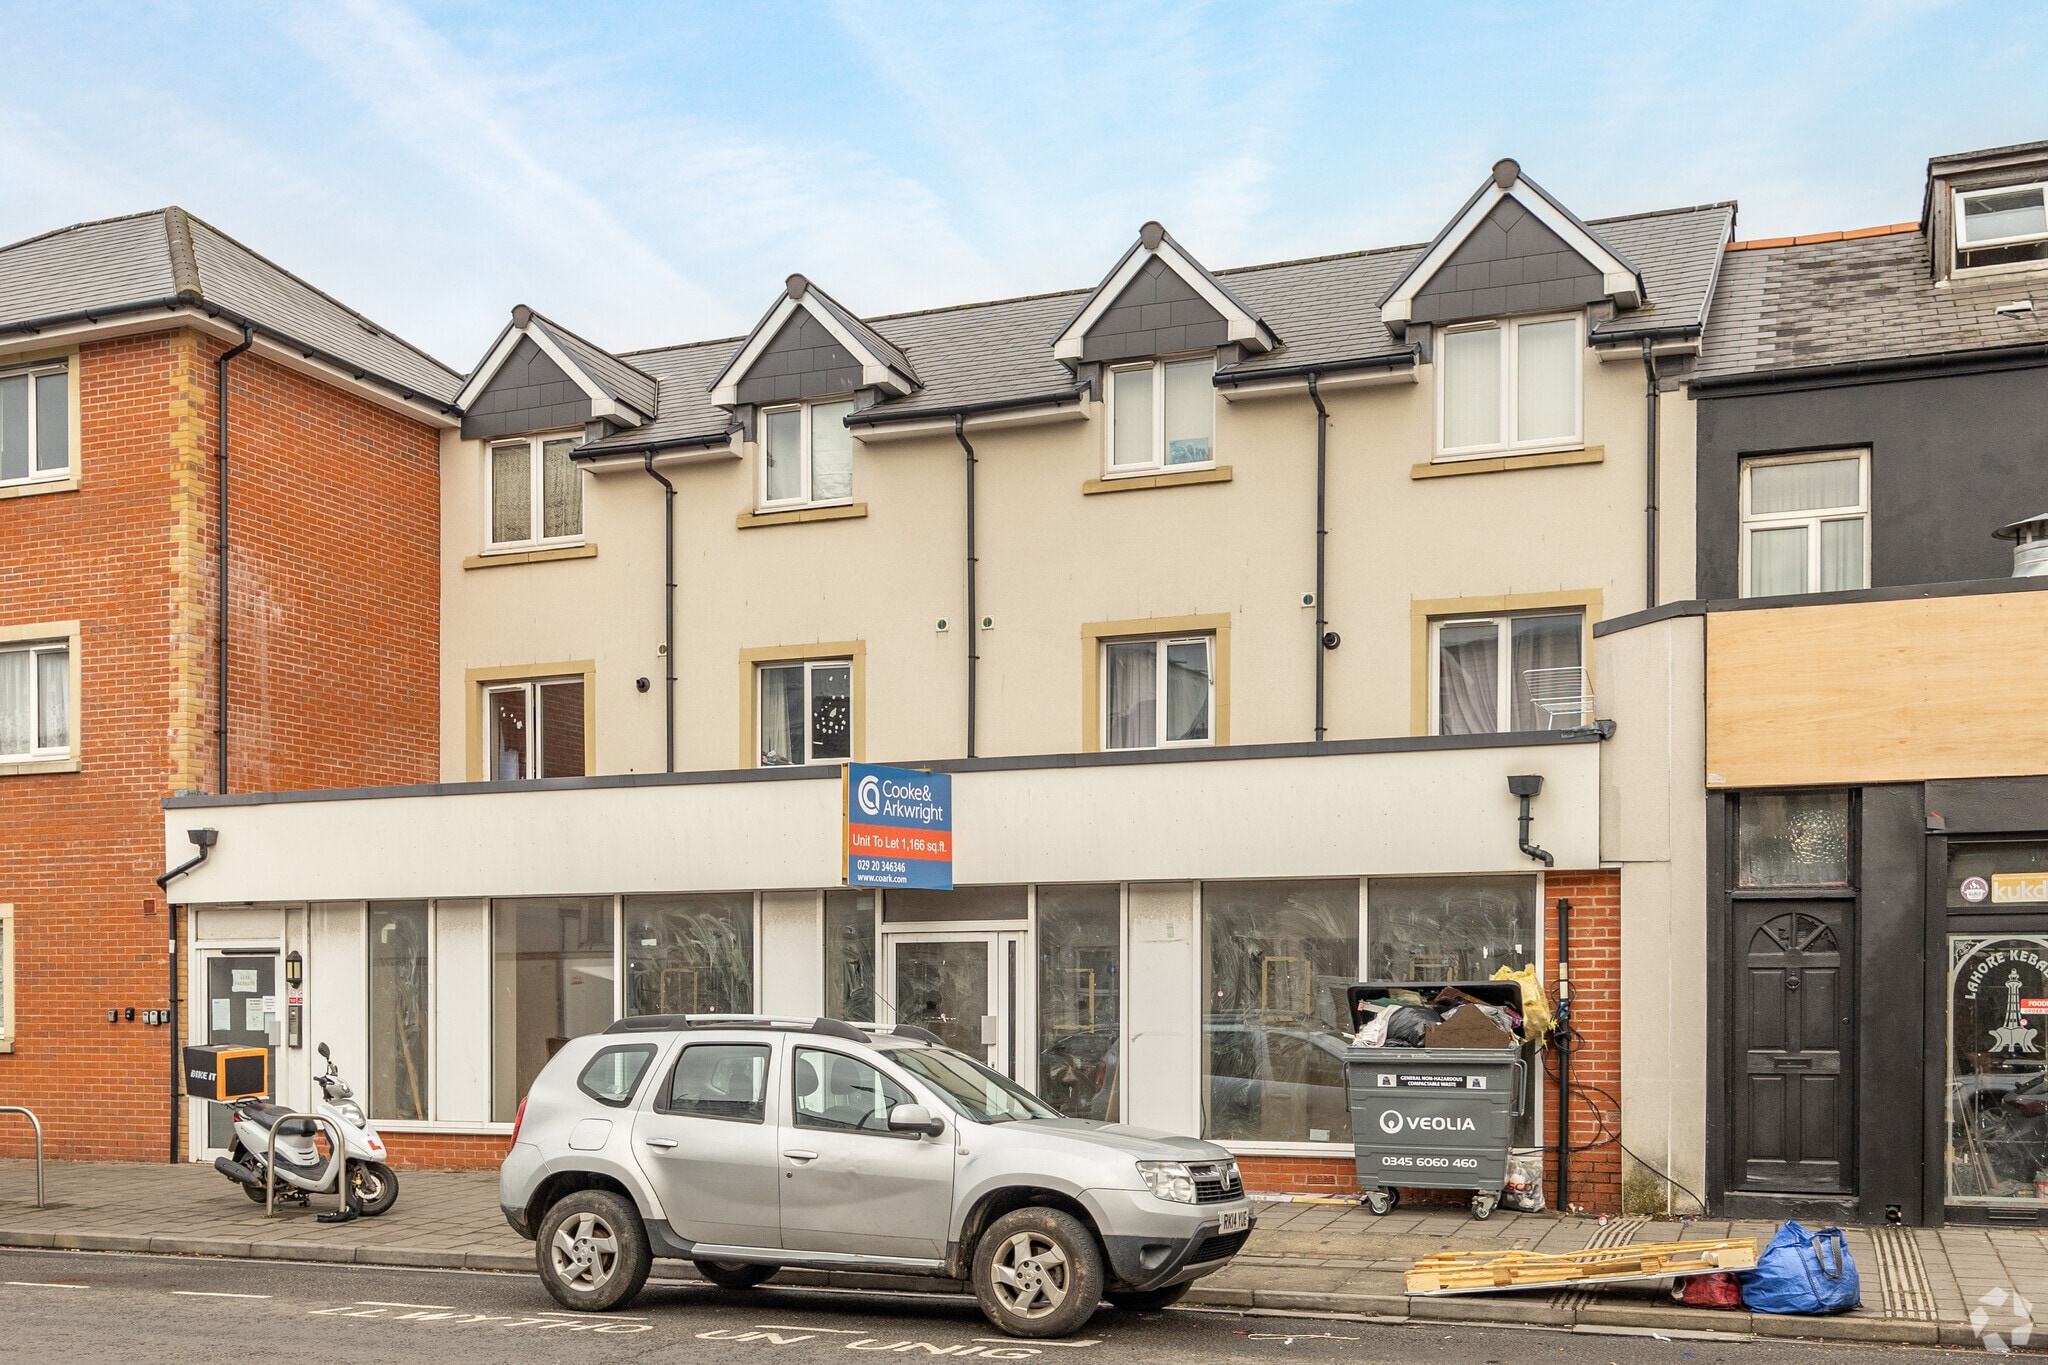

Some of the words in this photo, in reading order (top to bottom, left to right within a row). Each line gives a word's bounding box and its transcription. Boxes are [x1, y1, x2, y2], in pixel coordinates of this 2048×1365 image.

[882, 780, 932, 802] Cooke&
[882, 799, 943, 824] Arkwright
[852, 834, 871, 847] Unit
[872, 835, 883, 848] To
[885, 836, 899, 849] Let
[901, 838, 925, 851] 1,166
[927, 841, 947, 854] sq.ft.
[857, 859, 870, 870] 029
[871, 861, 880, 871] 20
[881, 861, 906, 872] 346346
[857, 873, 907, 884] www.coark.com
[1965, 952, 2005, 999] LAHORE
[190, 1069, 208, 1080] BIKE
[208, 1072, 217, 1081] IT
[1406, 1116, 1476, 1131] VEOLIA
[367, 1139, 382, 1151] L
[1382, 1156, 1413, 1166] 0345
[1416, 1157, 1449, 1167] 6060
[1452, 1158, 1478, 1168] 460
